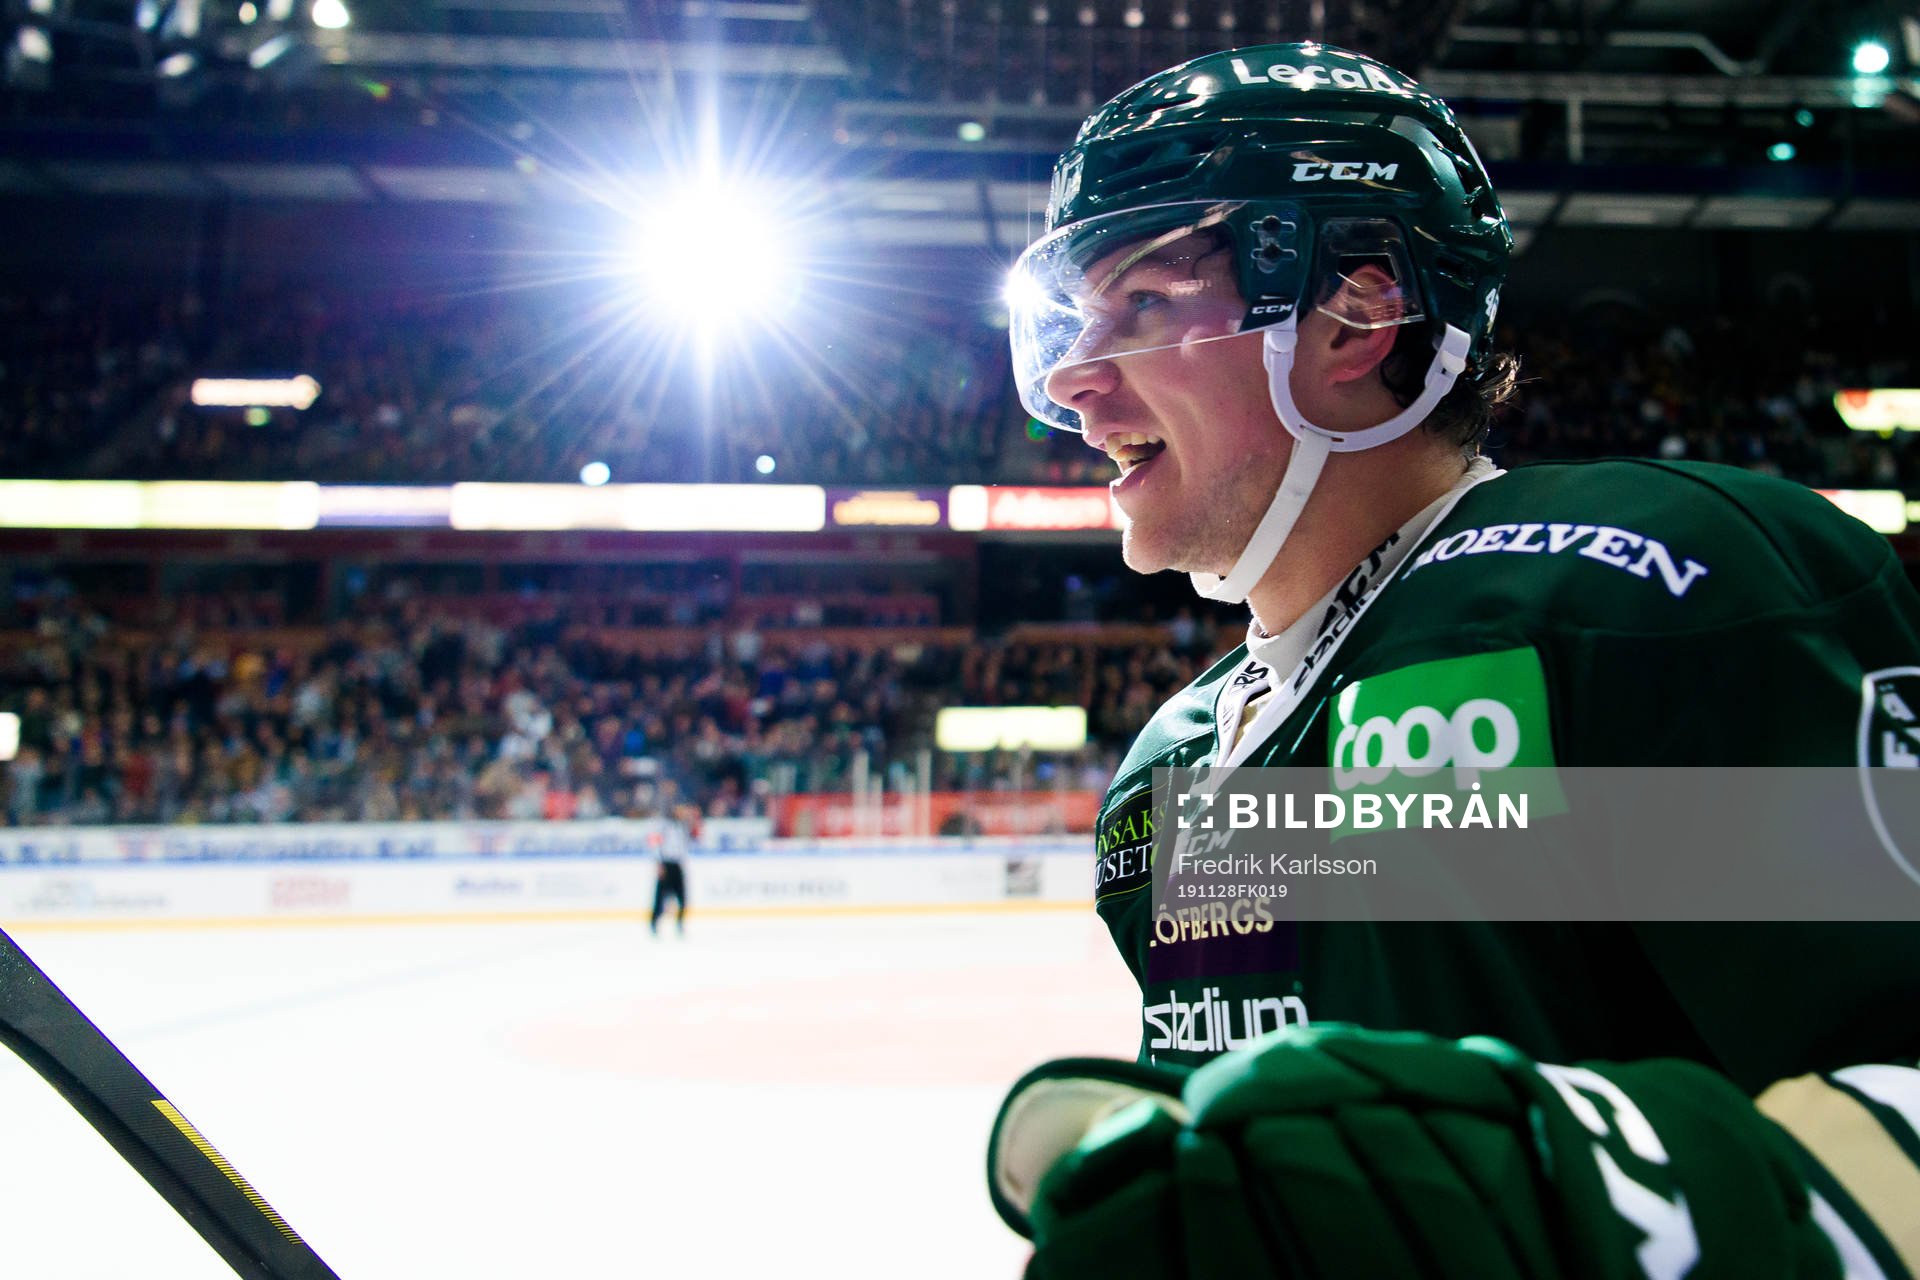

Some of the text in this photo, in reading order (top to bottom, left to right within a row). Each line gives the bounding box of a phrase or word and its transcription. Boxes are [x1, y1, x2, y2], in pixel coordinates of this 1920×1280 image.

[1291, 162, 1399, 182] CCM
[1251, 304, 1294, 315] CCM
[1333, 690, 1520, 791] coop
[1149, 896, 1274, 948] ÖFBERGS
[1143, 987, 1310, 1052] stadium
